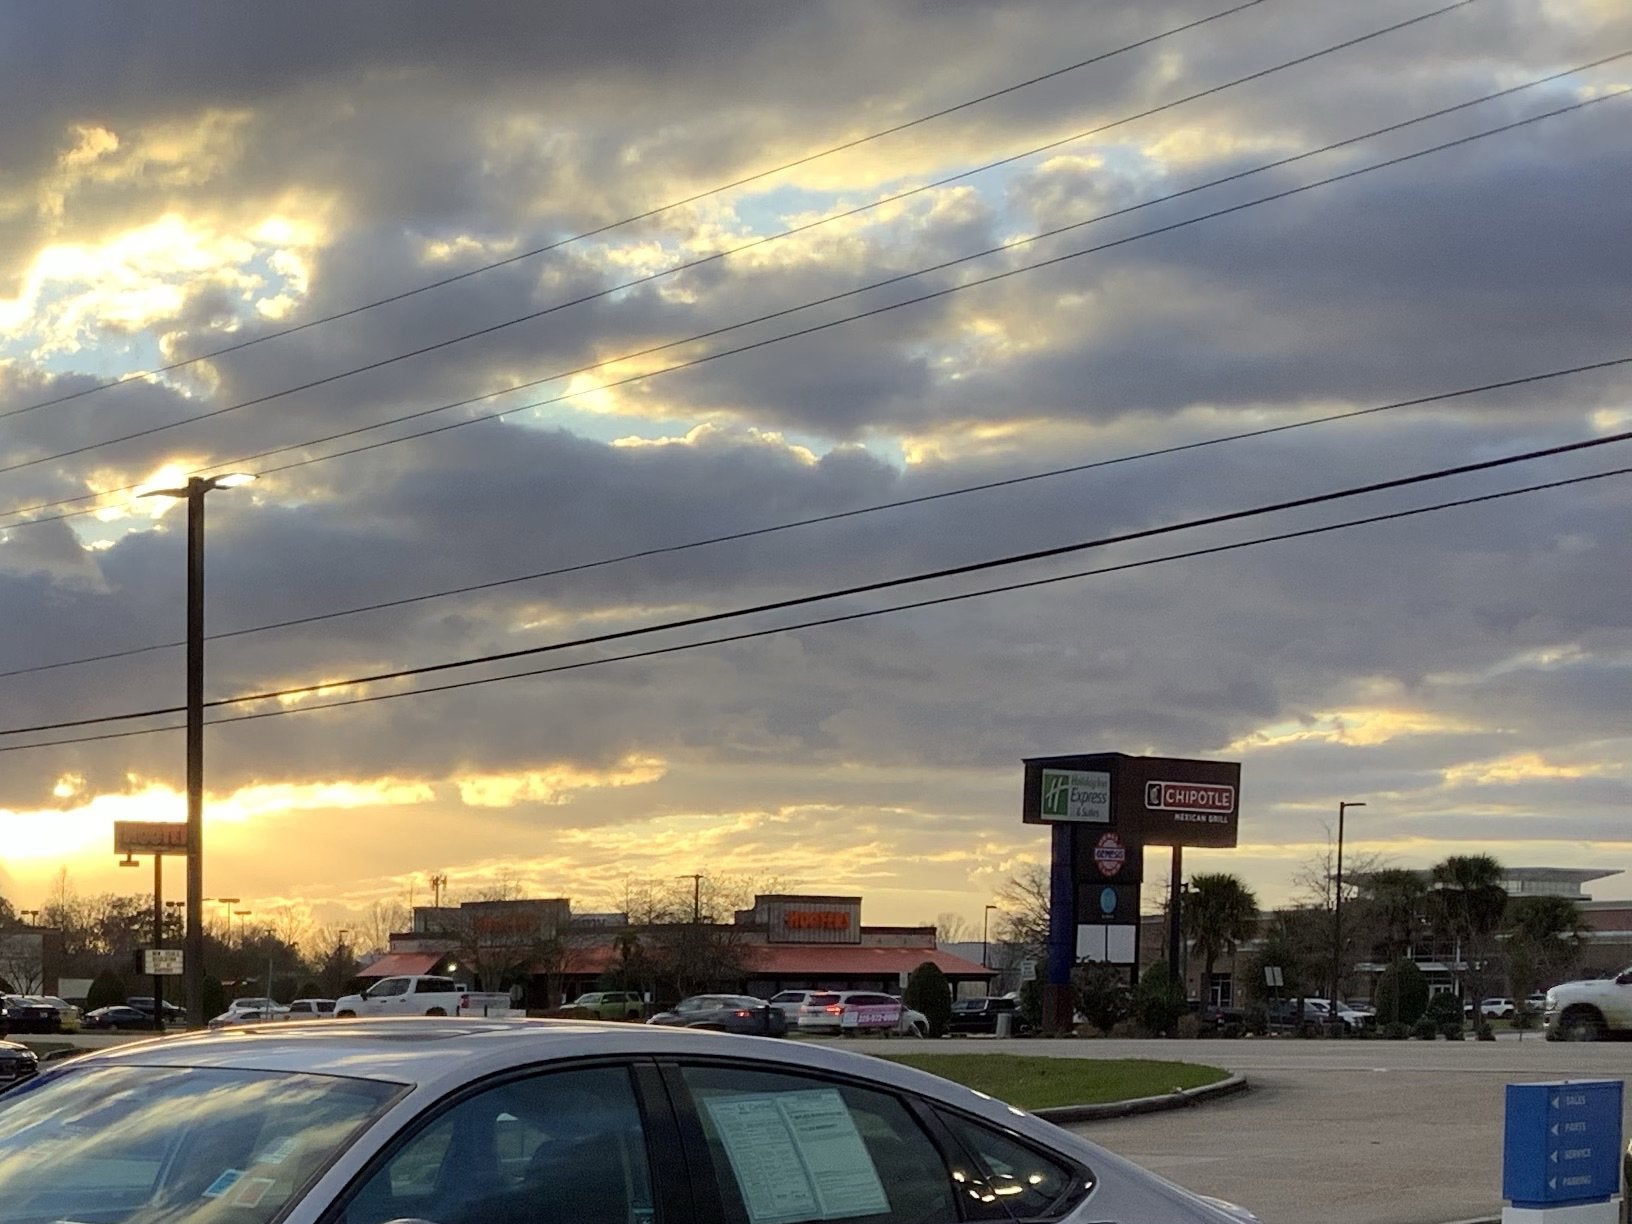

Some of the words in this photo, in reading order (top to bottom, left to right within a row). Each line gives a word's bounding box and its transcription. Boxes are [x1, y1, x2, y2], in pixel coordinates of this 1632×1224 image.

[1071, 787, 1107, 806] Express
[1166, 789, 1230, 807] CHIPOTLE
[1174, 813, 1207, 823] MEXICAN
[1208, 815, 1228, 824] GRILL
